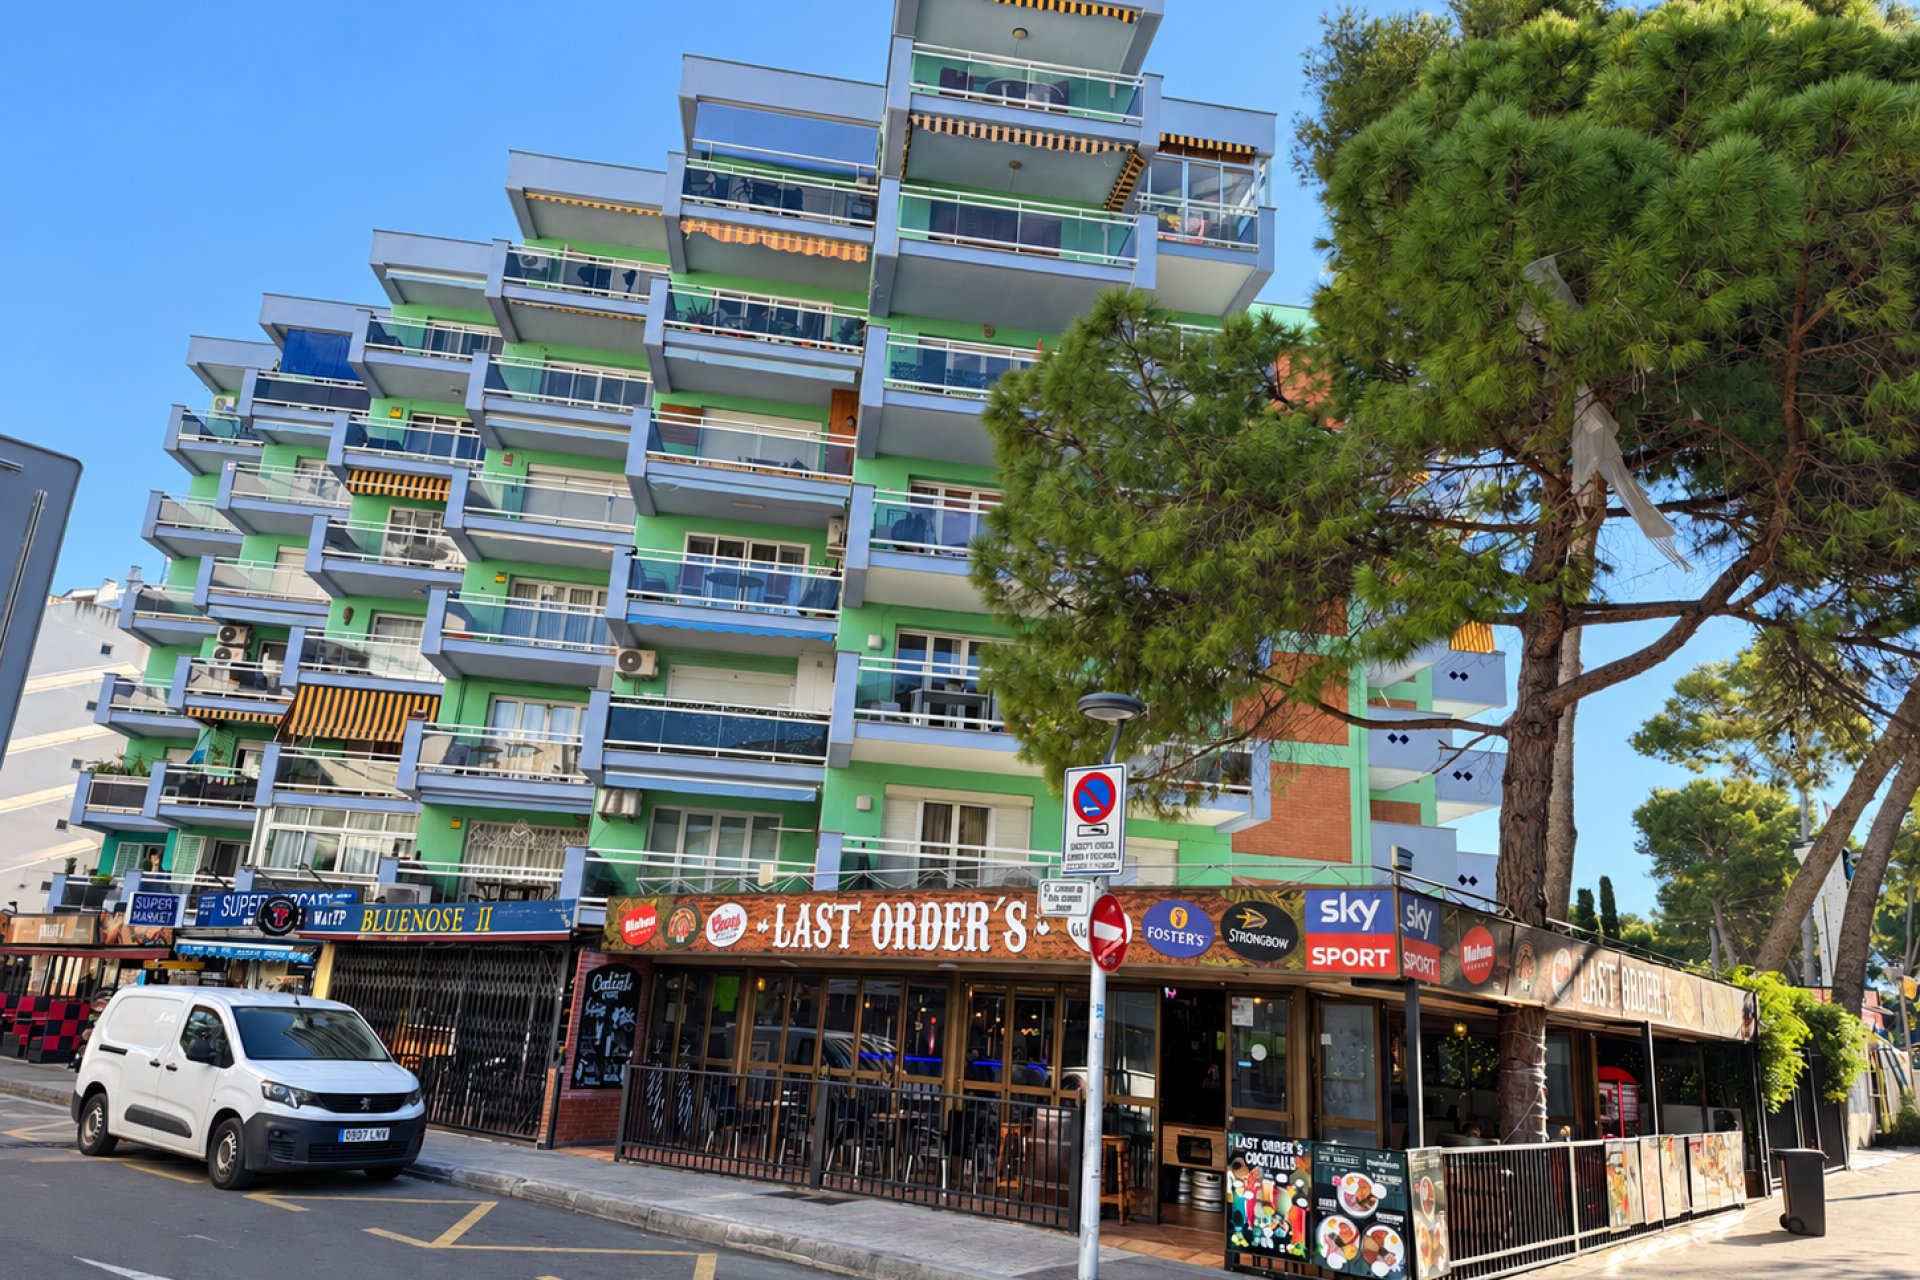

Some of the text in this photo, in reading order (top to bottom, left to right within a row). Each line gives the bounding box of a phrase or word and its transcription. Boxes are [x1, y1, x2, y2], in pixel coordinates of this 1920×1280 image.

[135, 896, 173, 911] SUPER
[1320, 891, 1381, 931] sky
[132, 910, 174, 924] MARKET
[360, 906, 494, 932] BLUENOSE II
[772, 901, 862, 950] LAST
[1406, 899, 1433, 940] sky
[1147, 926, 1205, 947] FOSTER'S
[1228, 927, 1290, 950] STRONGBOW
[1312, 946, 1391, 968] SPORT
[1403, 951, 1437, 976] SPORT
[1578, 955, 1617, 1009] LAST
[1235, 1134, 1259, 1150] LAST
